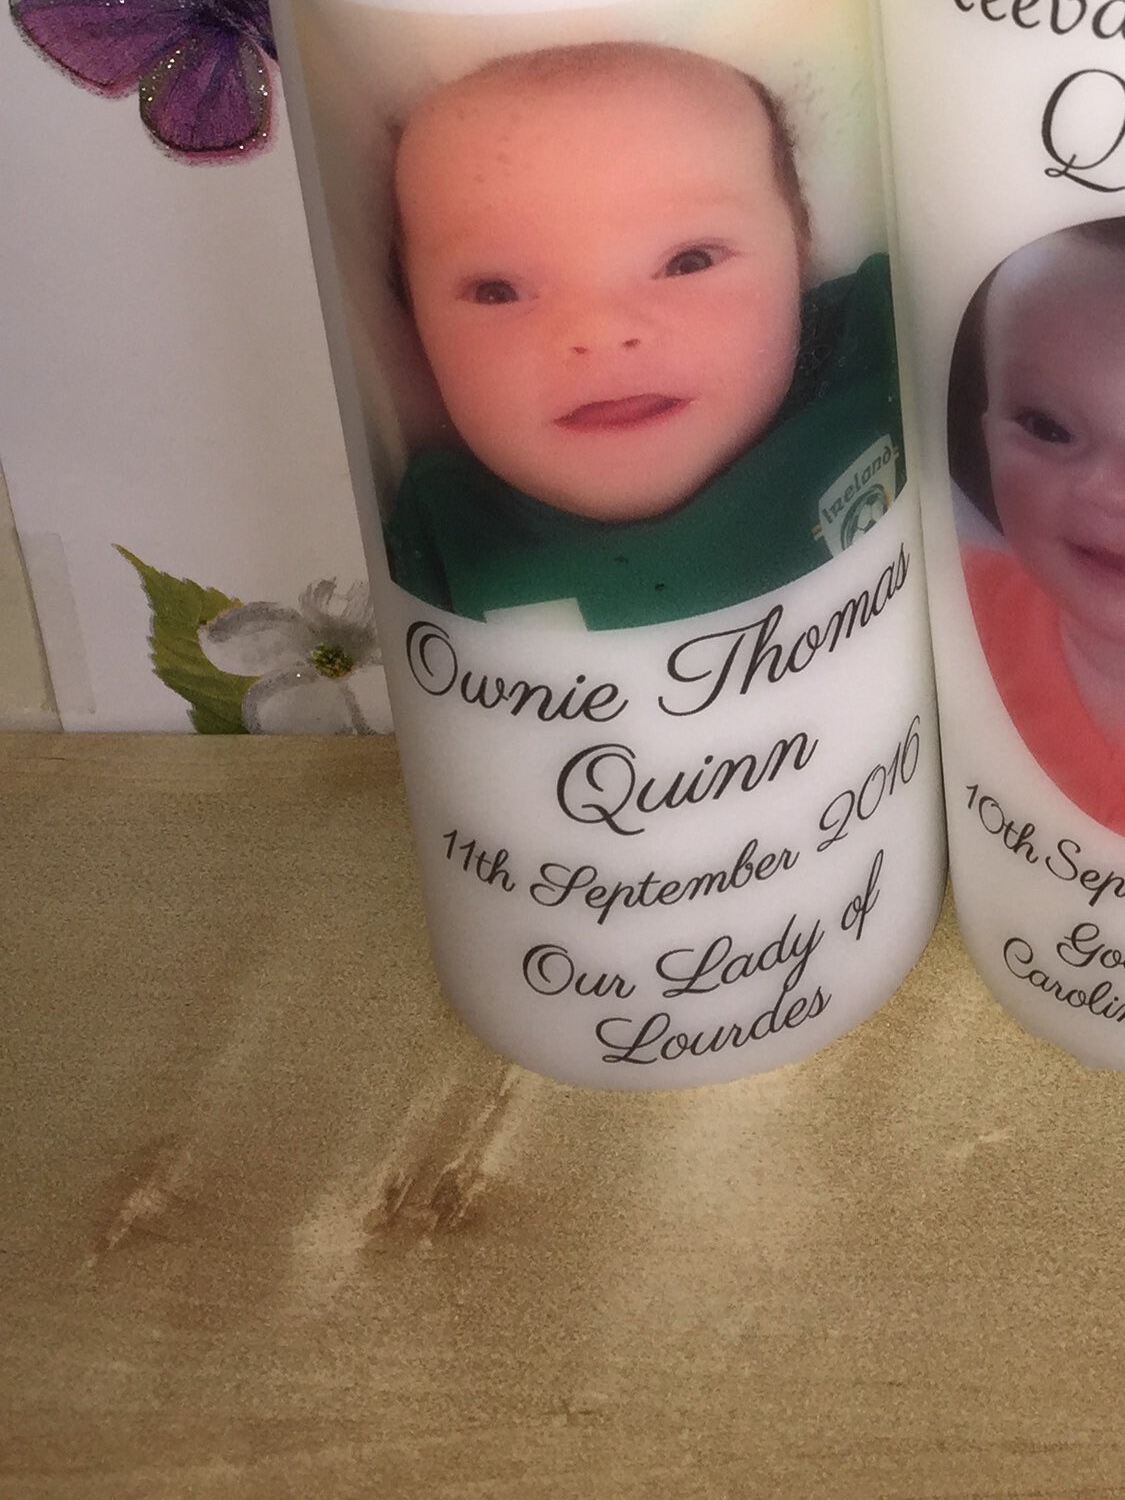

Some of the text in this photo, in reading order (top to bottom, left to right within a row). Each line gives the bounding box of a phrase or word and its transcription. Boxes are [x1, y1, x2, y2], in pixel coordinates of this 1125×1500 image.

[406, 542, 910, 722] Ownie Thomas
[443, 714, 921, 925] 11th September 2016
[557, 731, 818, 835] Quinn
[965, 784, 1039, 864] 10th
[522, 849, 884, 1000] Our Lady of
[595, 985, 832, 1065] Lourdes
